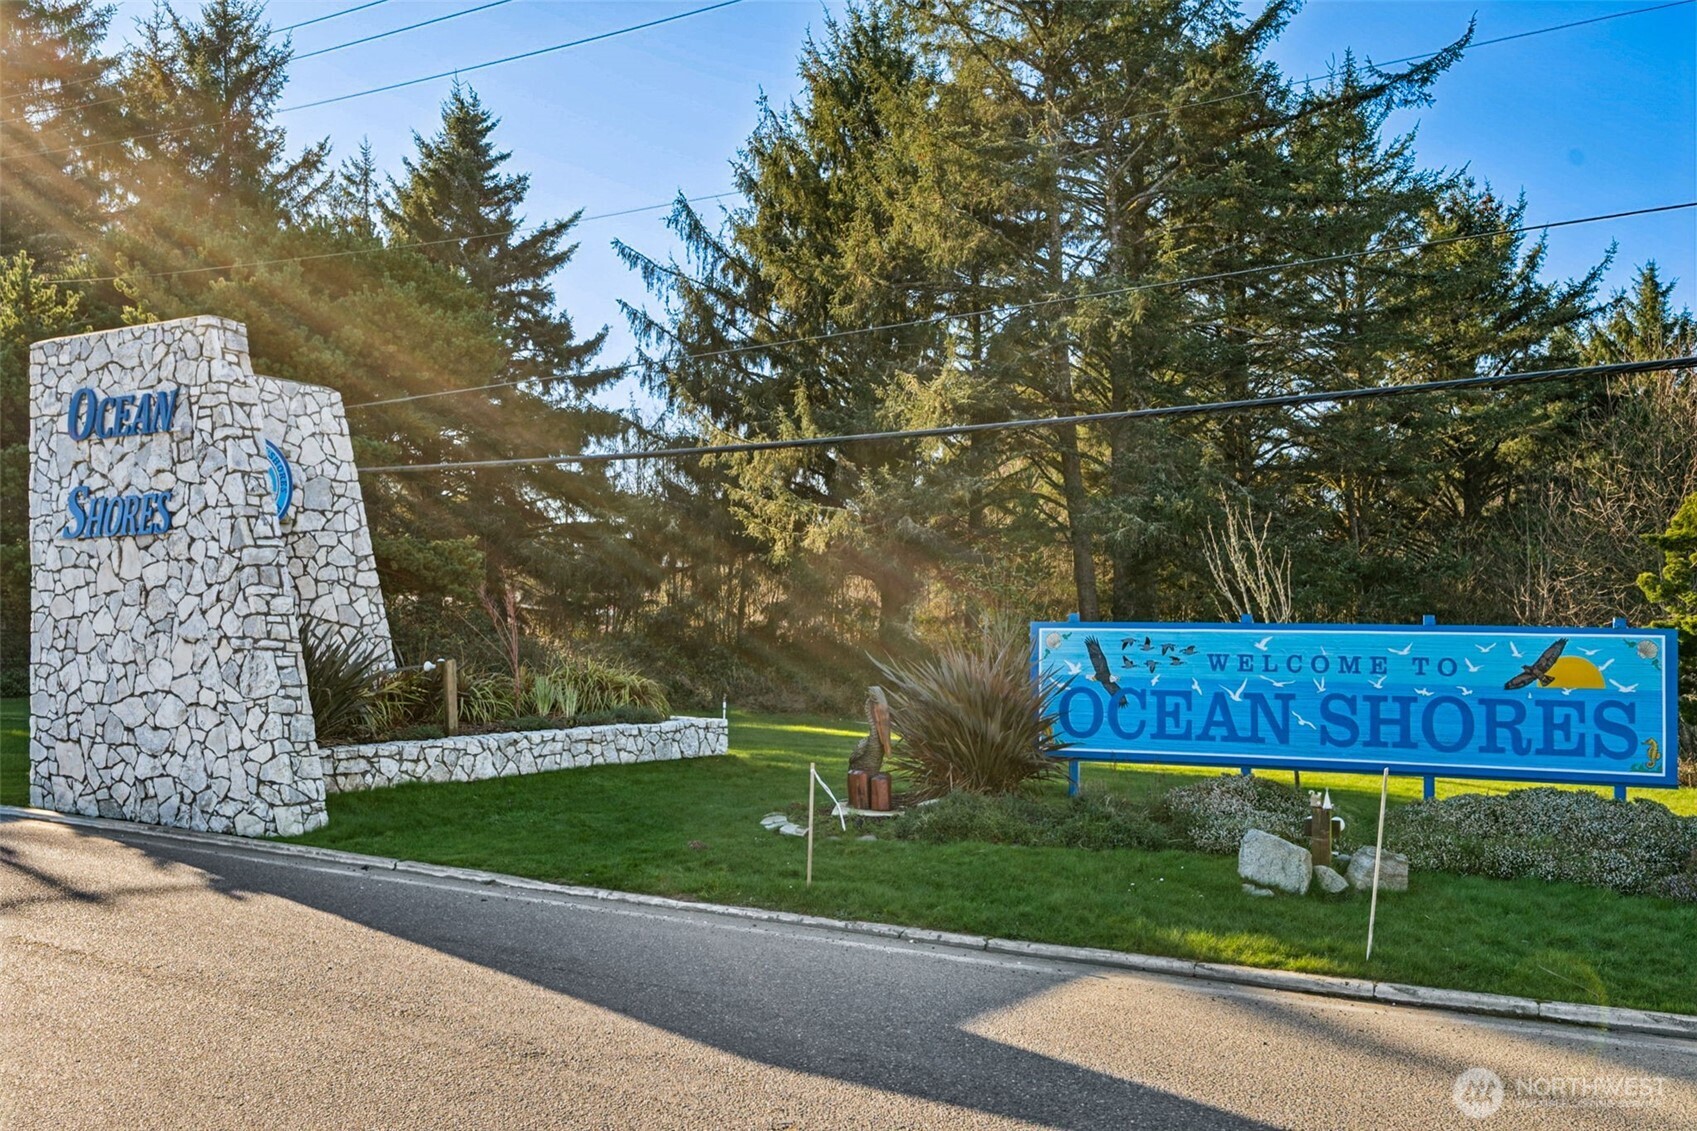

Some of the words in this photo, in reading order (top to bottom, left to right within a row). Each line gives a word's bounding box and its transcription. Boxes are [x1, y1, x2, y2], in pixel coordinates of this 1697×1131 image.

[67, 388, 179, 441] OCEAN
[268, 451, 288, 493] SHORES
[62, 487, 173, 539] SHORES
[1207, 653, 1388, 676] WELCOME
[1412, 656, 1458, 677] TO
[1061, 687, 1296, 745] OCEAN
[1320, 694, 1639, 760] SHORES
